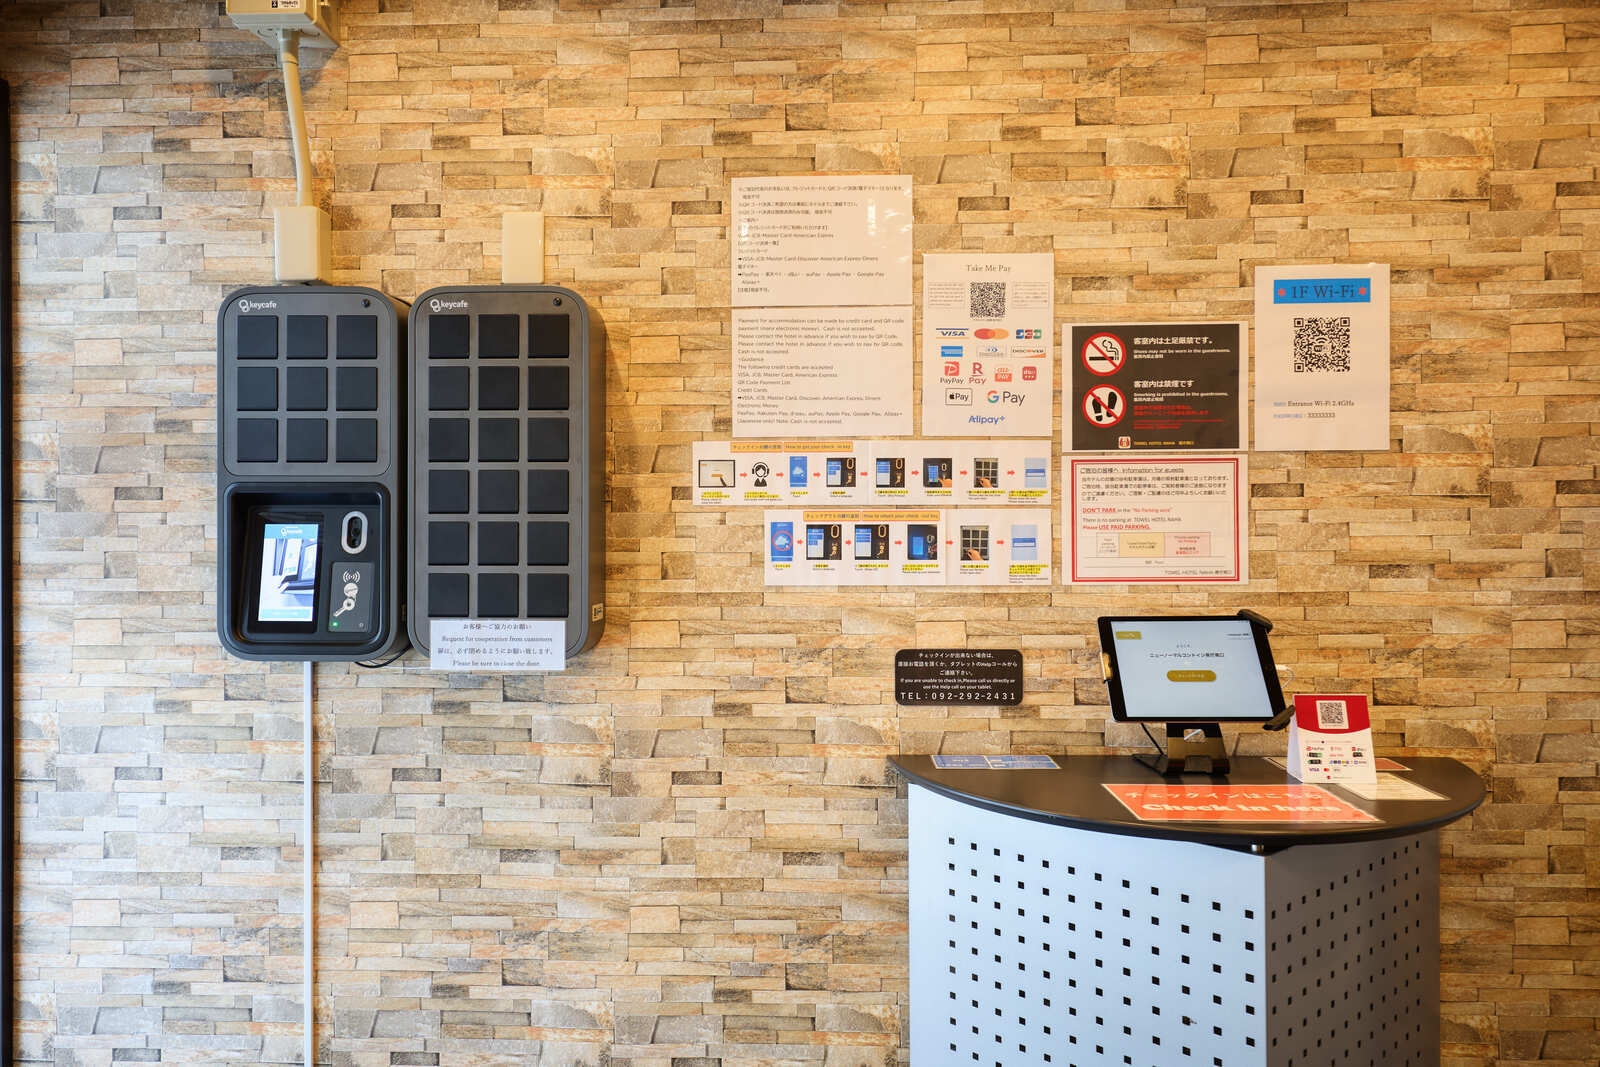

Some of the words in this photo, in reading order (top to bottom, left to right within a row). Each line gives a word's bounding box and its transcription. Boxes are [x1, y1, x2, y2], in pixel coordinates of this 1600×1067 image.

[966, 264, 982, 272] Take
[985, 264, 996, 272] Me
[998, 264, 1012, 273] Pay
[1314, 285, 1354, 298] Wi-Fi
[249, 301, 276, 309] keycafe
[940, 377, 964, 385] PayPay
[968, 377, 986, 385] Pay
[1002, 392, 1026, 406] Pay
[1142, 804, 1235, 812] Check
